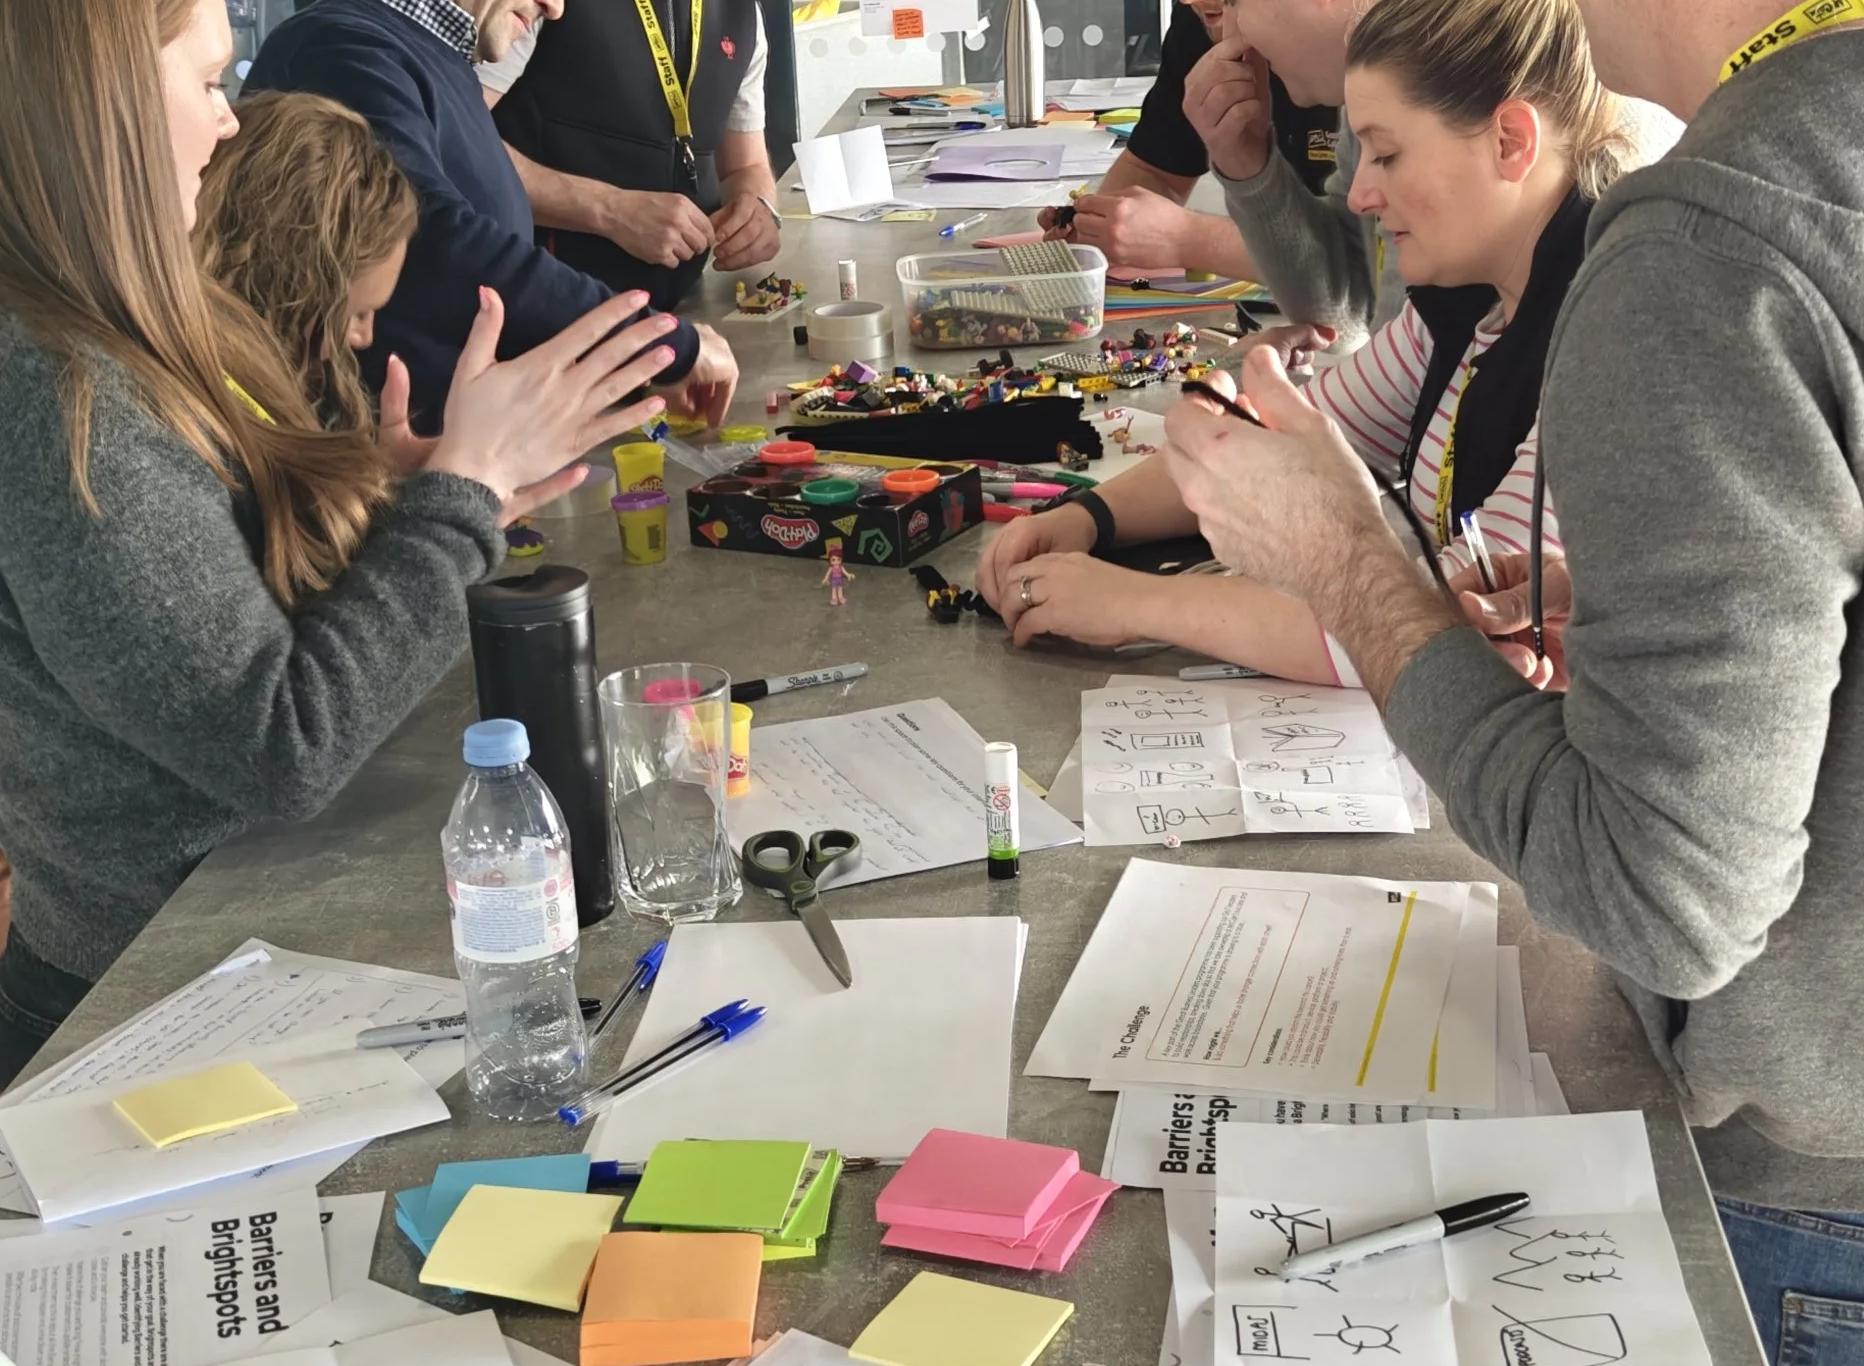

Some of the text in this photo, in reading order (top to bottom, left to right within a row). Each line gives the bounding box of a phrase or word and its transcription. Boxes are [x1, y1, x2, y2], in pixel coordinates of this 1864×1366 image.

[639, 0, 655, 29] Staff
[657, 57, 674, 86] Staff
[1729, 20, 1796, 75] Staff
[764, 519, 817, 543] Play-Doh
[1113, 1004, 1150, 1060] The Challenge
[1159, 1102, 1195, 1173] Barriers
[1196, 1095, 1237, 1174] Brightsp
[204, 1218, 247, 1338] Brightspots
[248, 1211, 289, 1335] Barriers and
[1247, 1315, 1268, 1351] MIDAS
